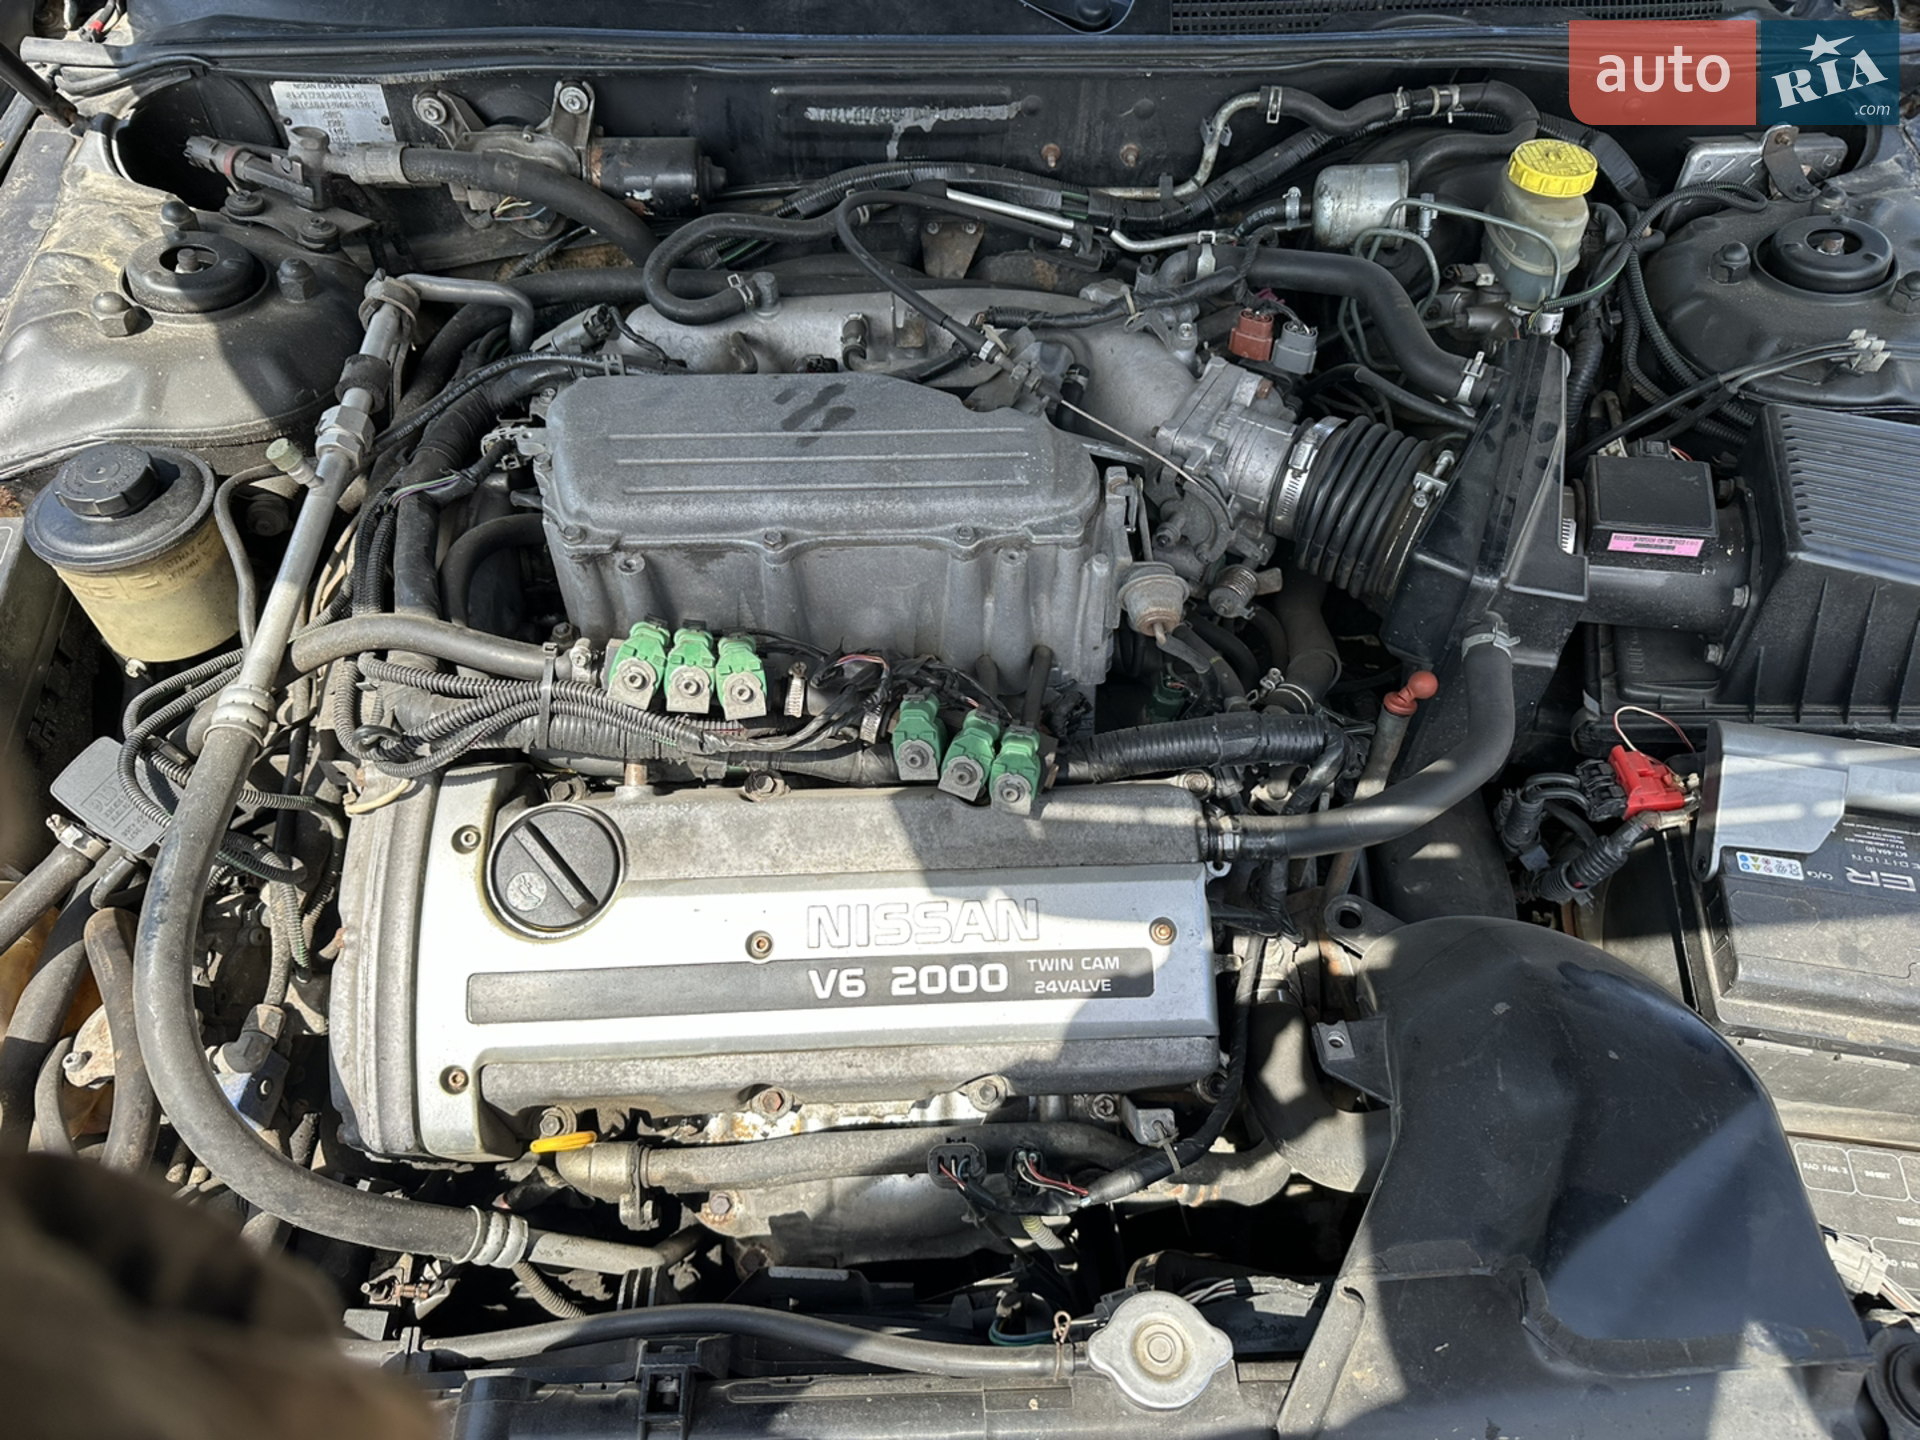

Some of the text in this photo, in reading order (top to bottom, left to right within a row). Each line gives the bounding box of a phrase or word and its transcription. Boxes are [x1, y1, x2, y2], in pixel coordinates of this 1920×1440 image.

[1246, 206, 1276, 225] PETRO
[806, 897, 1040, 949] NISSAN
[1026, 956, 1120, 972] TWIN CAM
[808, 963, 1008, 999] V6 2000
[1034, 978, 1112, 995] 24VALVE
